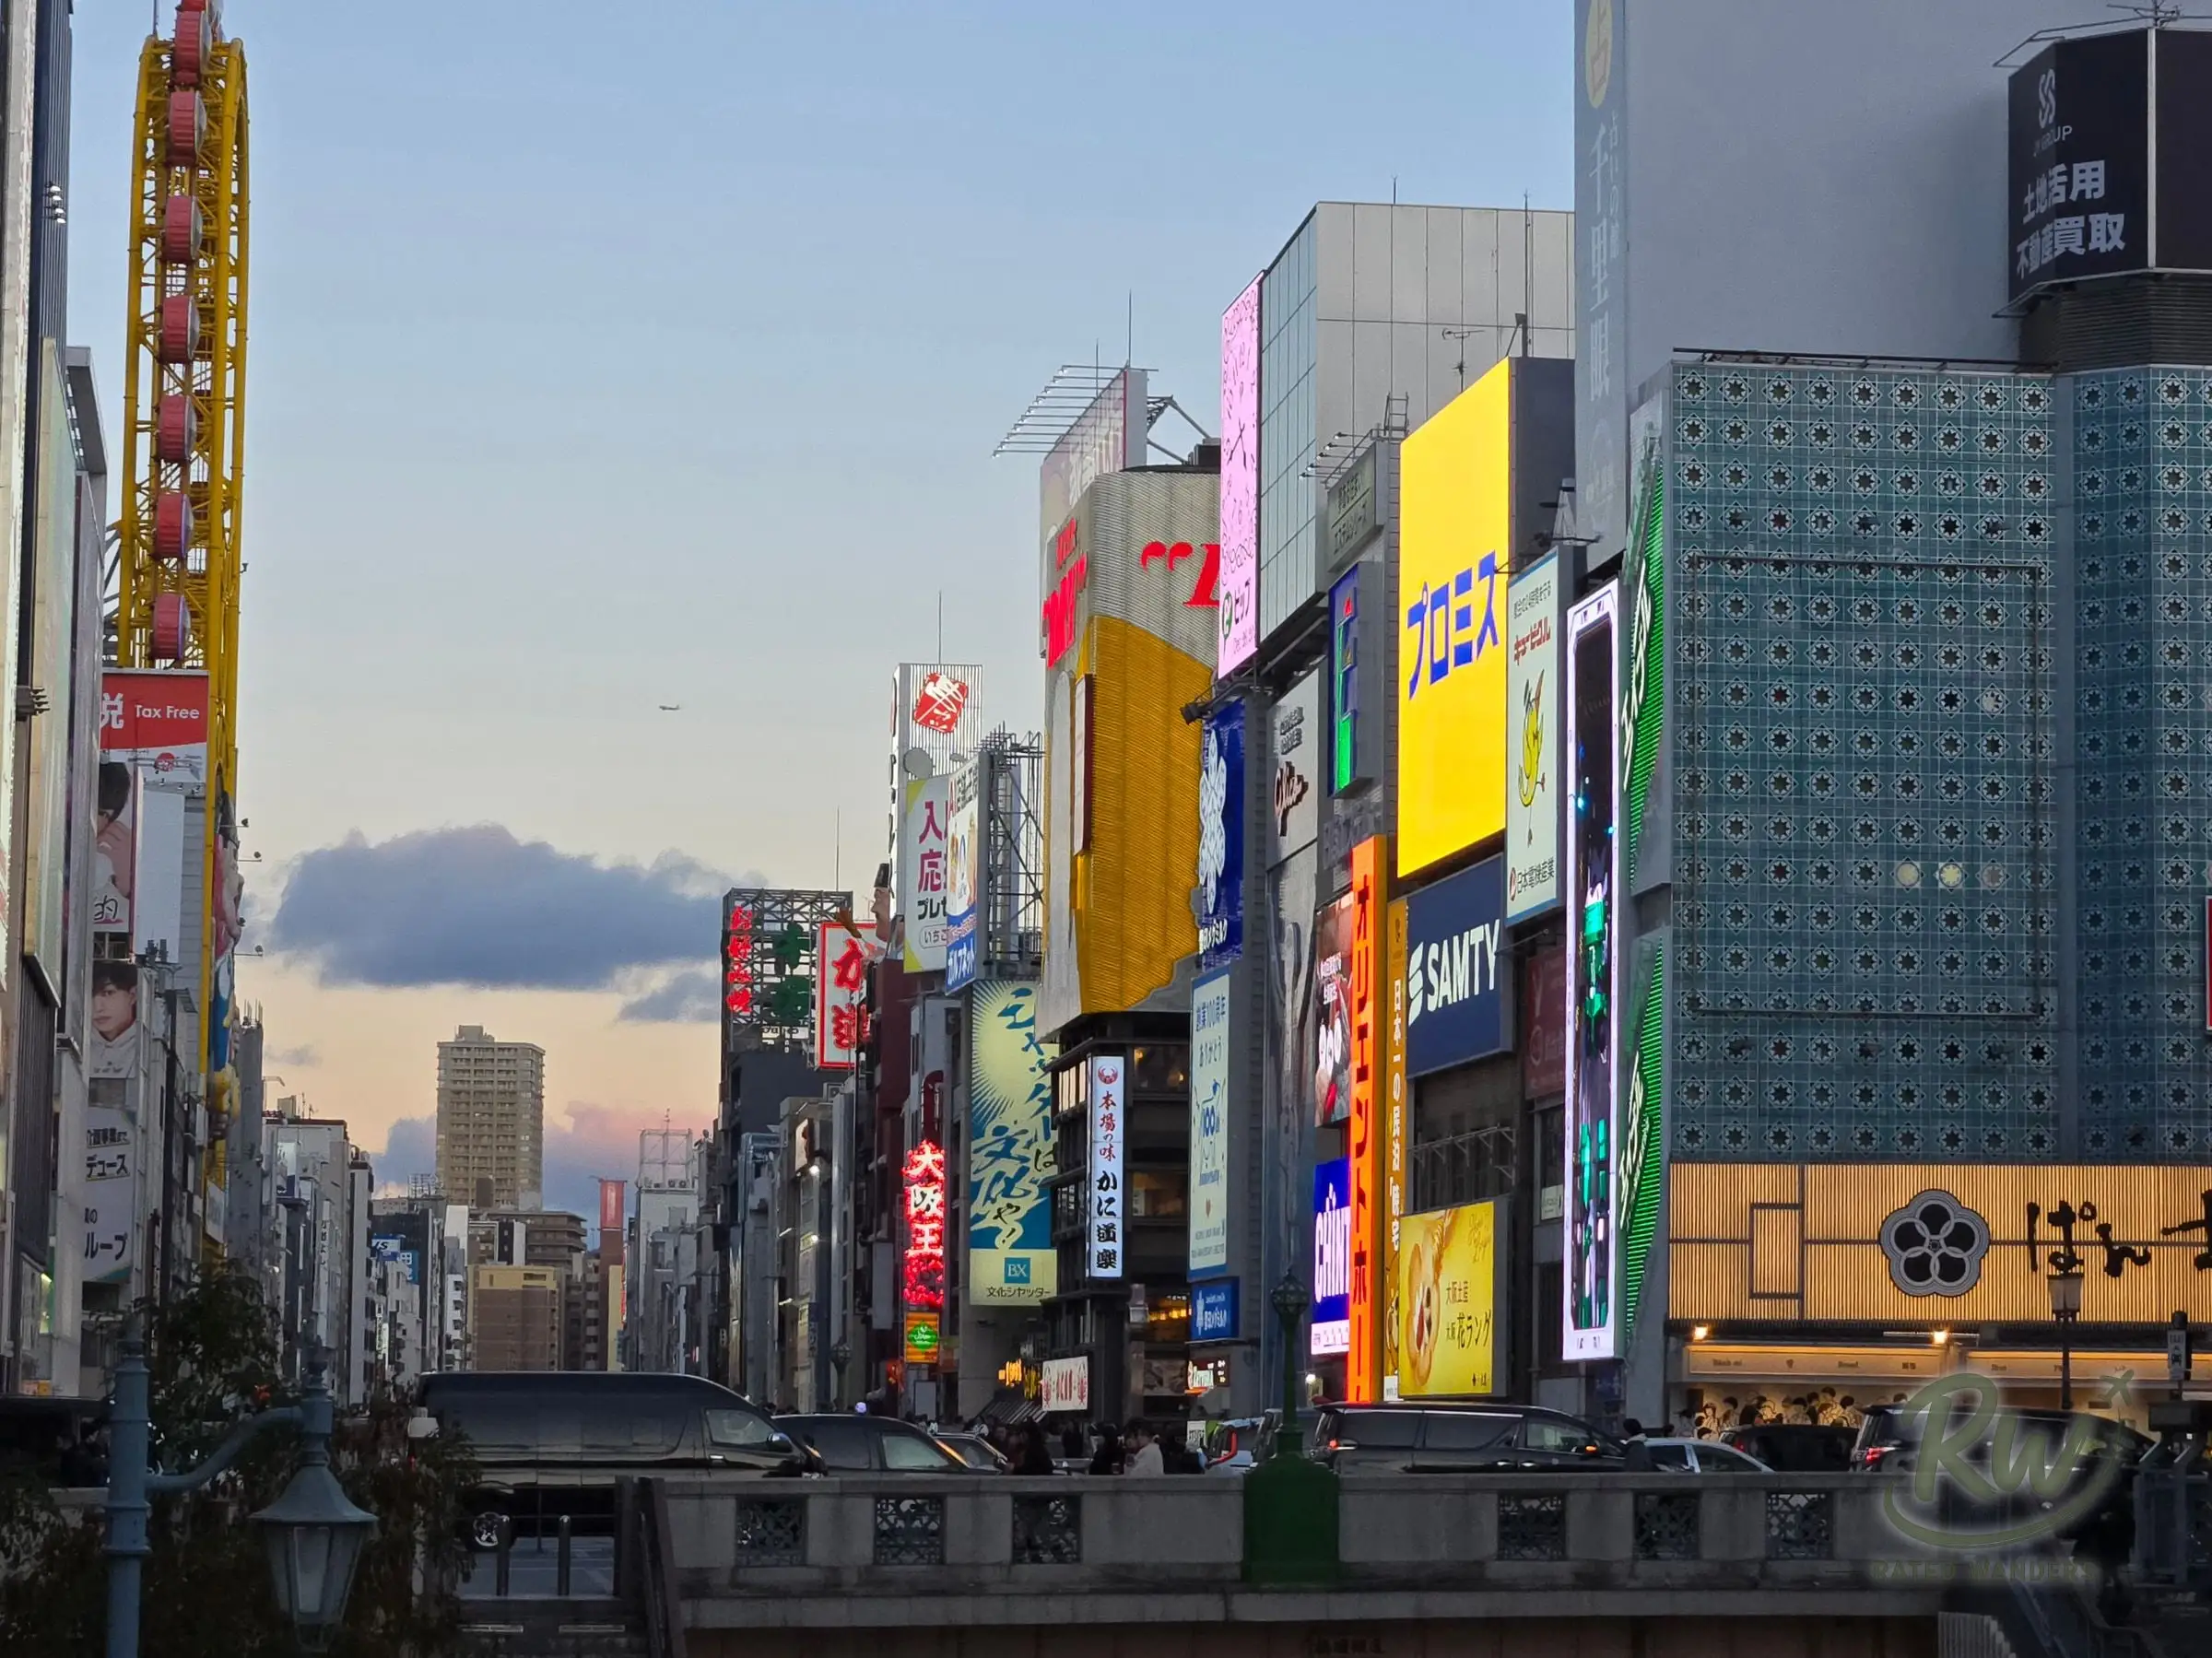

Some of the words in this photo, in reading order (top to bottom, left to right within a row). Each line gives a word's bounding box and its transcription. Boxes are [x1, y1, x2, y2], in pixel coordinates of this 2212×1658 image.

[2022, 159, 2106, 225] 土地活用
[1588, 122, 1612, 404] 千里眼
[2016, 212, 2126, 280] 不動産買取
[1407, 549, 1500, 700] プロミス
[135, 705, 162, 719] Tax
[165, 705, 200, 720] Free
[1427, 920, 1500, 1012] SAMTY
[1099, 1090, 1117, 1162] 本場の味
[1007, 1263, 1028, 1278] BX
